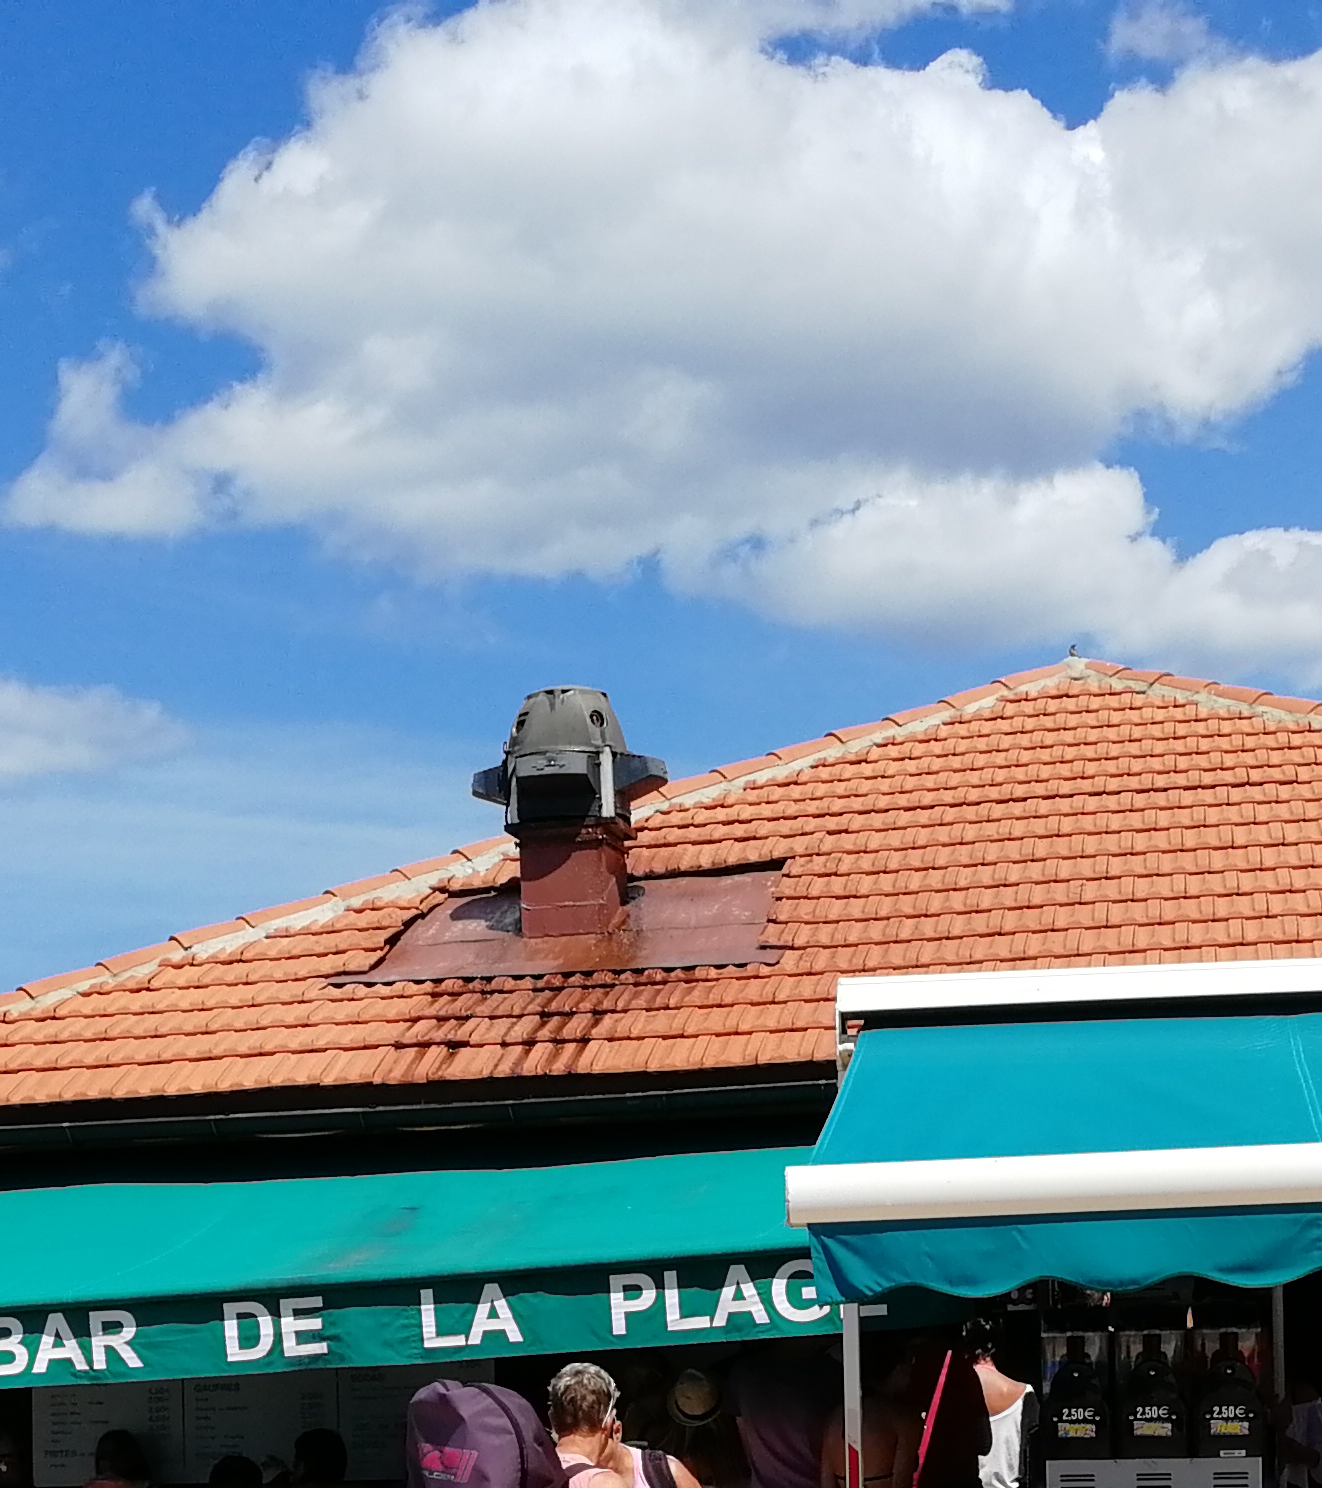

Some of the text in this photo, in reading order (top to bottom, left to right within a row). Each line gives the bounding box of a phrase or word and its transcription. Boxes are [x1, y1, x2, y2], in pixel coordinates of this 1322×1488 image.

[223, 1296, 328, 1362] DE
[420, 1283, 524, 1349] LA
[609, 1259, 887, 1335] PLAG
